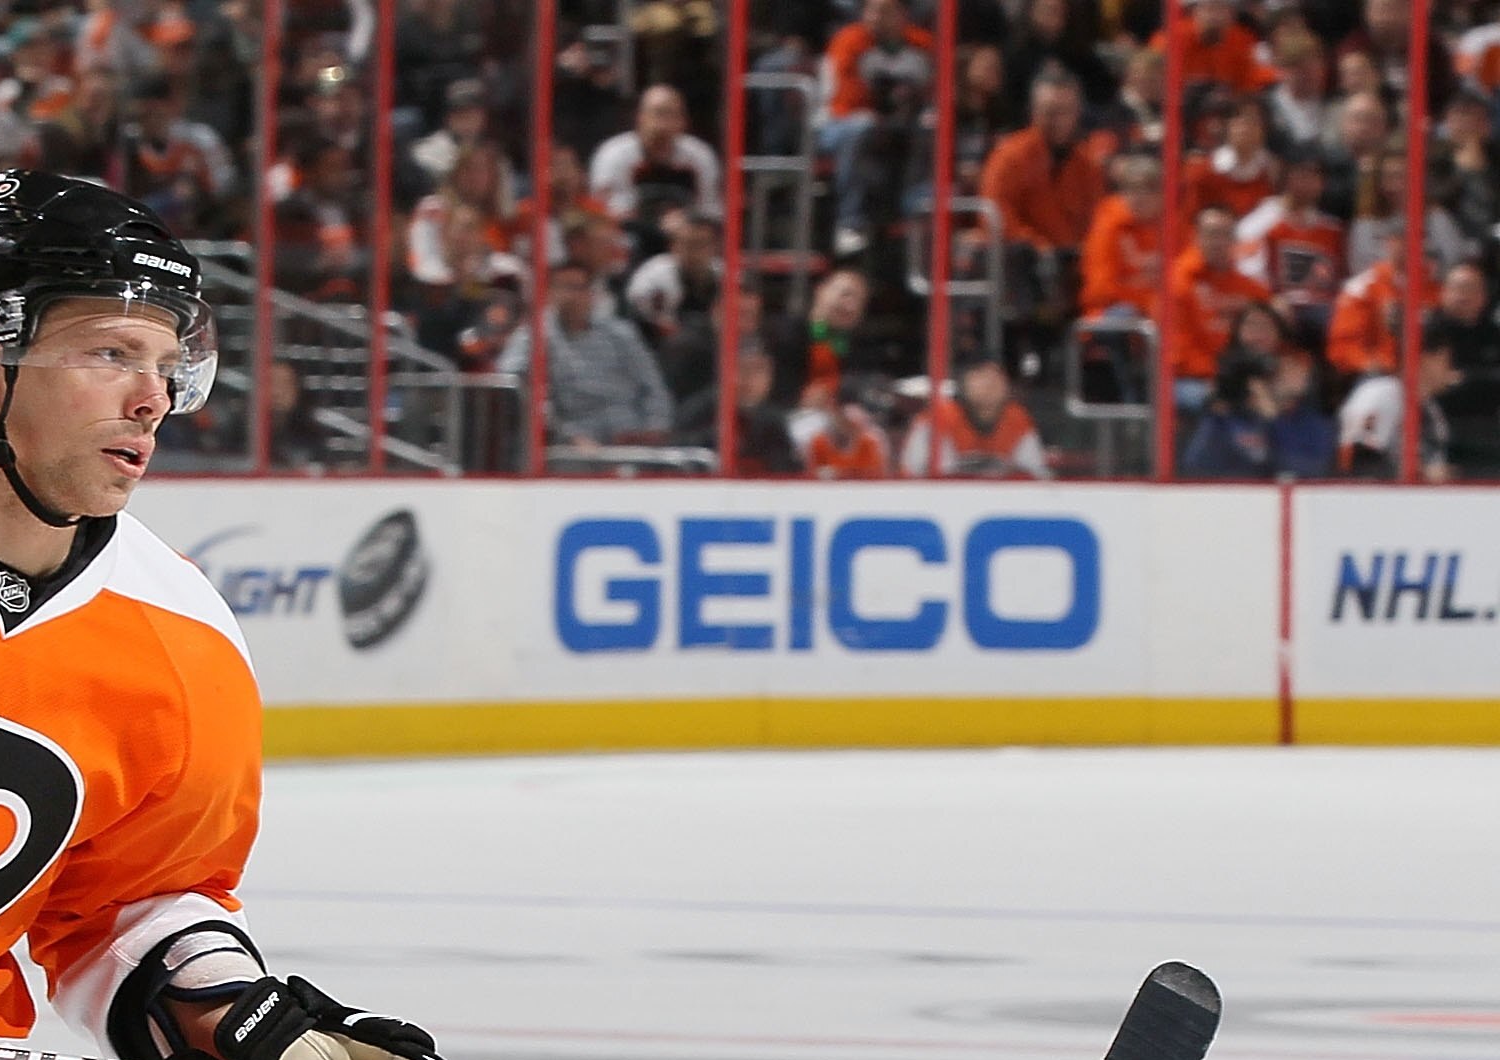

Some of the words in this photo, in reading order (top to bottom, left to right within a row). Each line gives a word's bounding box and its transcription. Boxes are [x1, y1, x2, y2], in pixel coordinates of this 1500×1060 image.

[133, 253, 191, 278] BAUER
[554, 516, 1102, 653] GEICO
[235, 991, 280, 1043] BAUER
